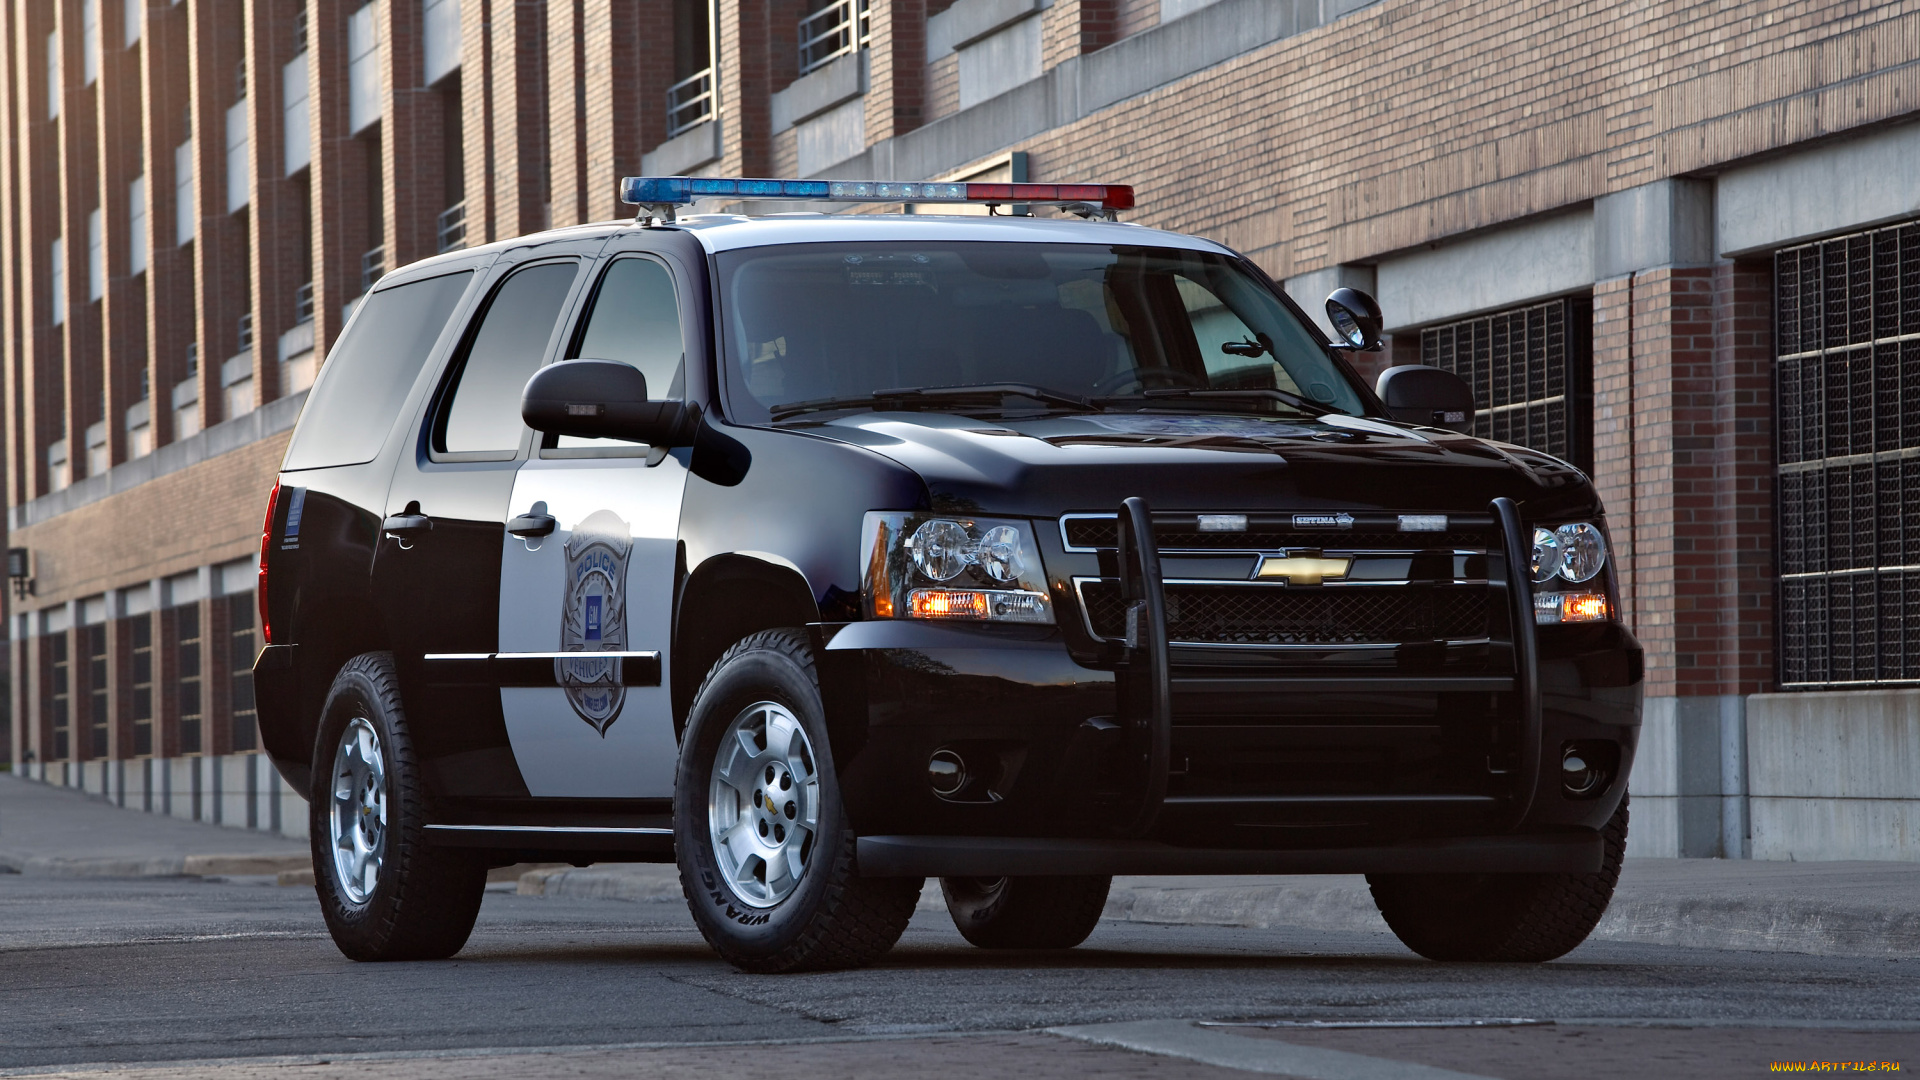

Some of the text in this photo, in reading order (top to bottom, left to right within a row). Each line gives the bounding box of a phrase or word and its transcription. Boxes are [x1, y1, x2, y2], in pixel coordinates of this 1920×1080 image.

[1296, 516, 1336, 524] SETINA
[576, 551, 616, 582] POLICE
[588, 605, 599, 624] GM
[569, 657, 608, 678] VEHICLES
